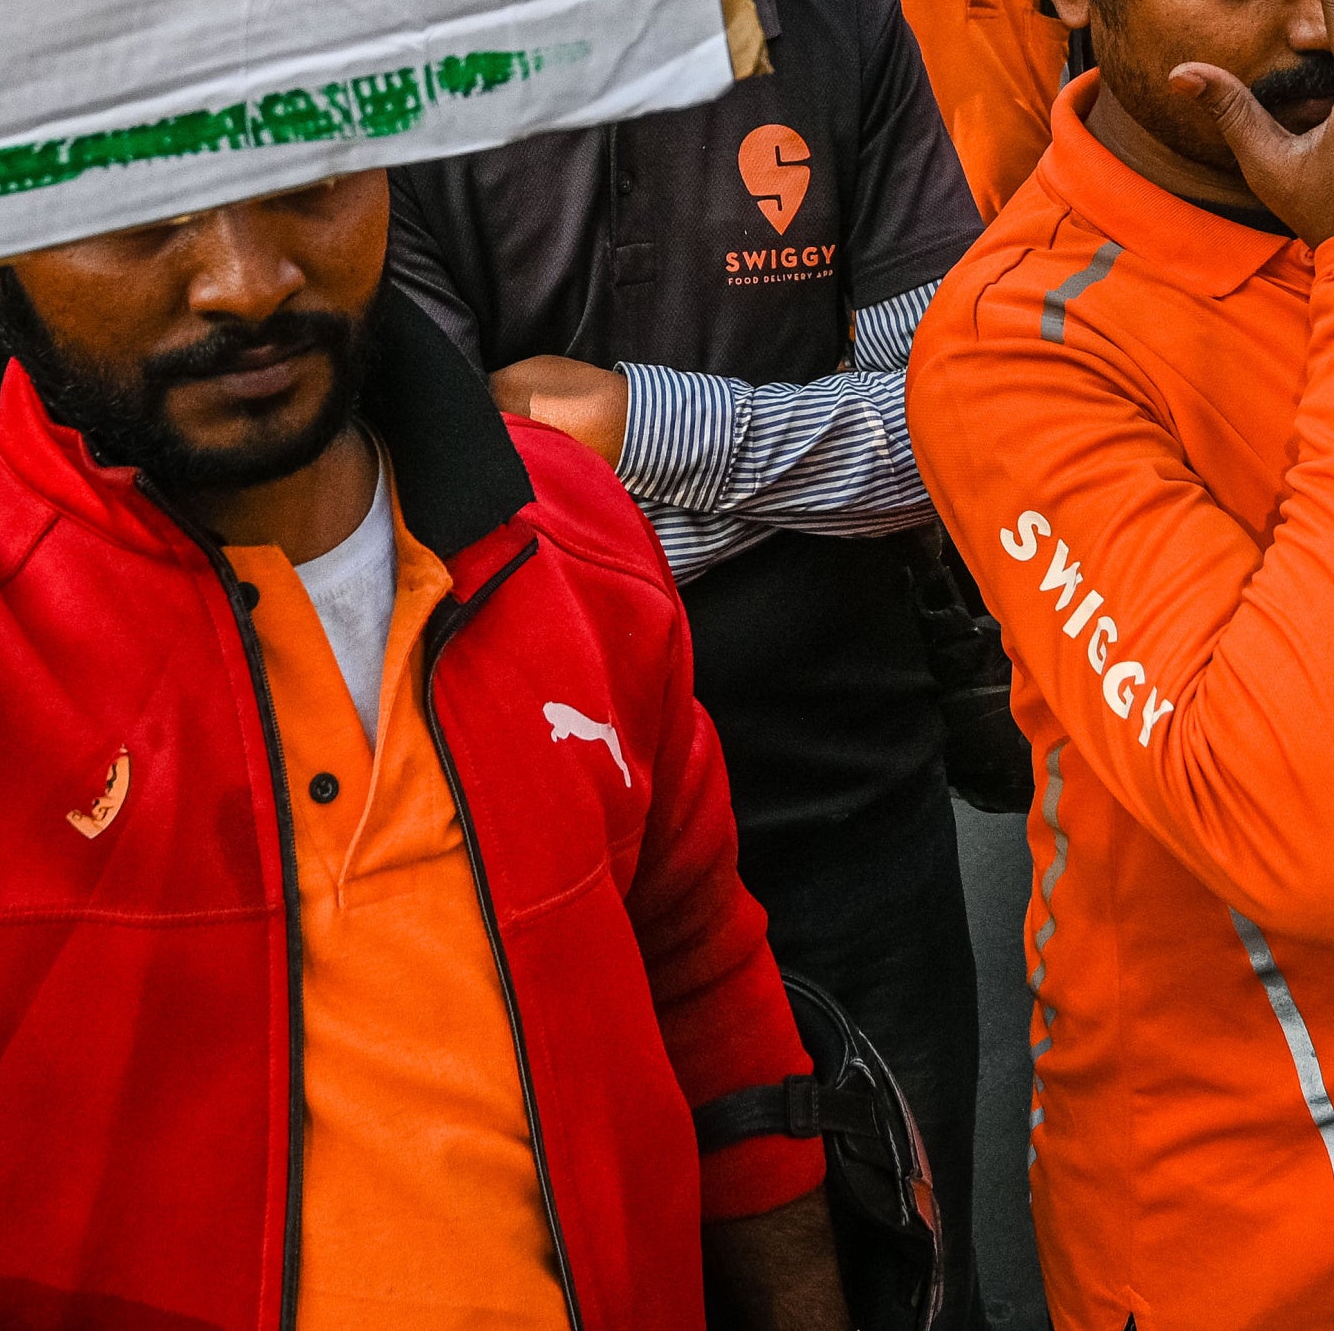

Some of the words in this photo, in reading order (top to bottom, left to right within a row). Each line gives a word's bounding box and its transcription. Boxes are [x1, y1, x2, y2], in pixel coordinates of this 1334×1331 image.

[725, 244, 836, 273] SWIGGY
[728, 277, 759, 286] FOOD
[763, 272, 813, 284] DELIVERY
[999, 509, 1175, 749] SWIGGY
